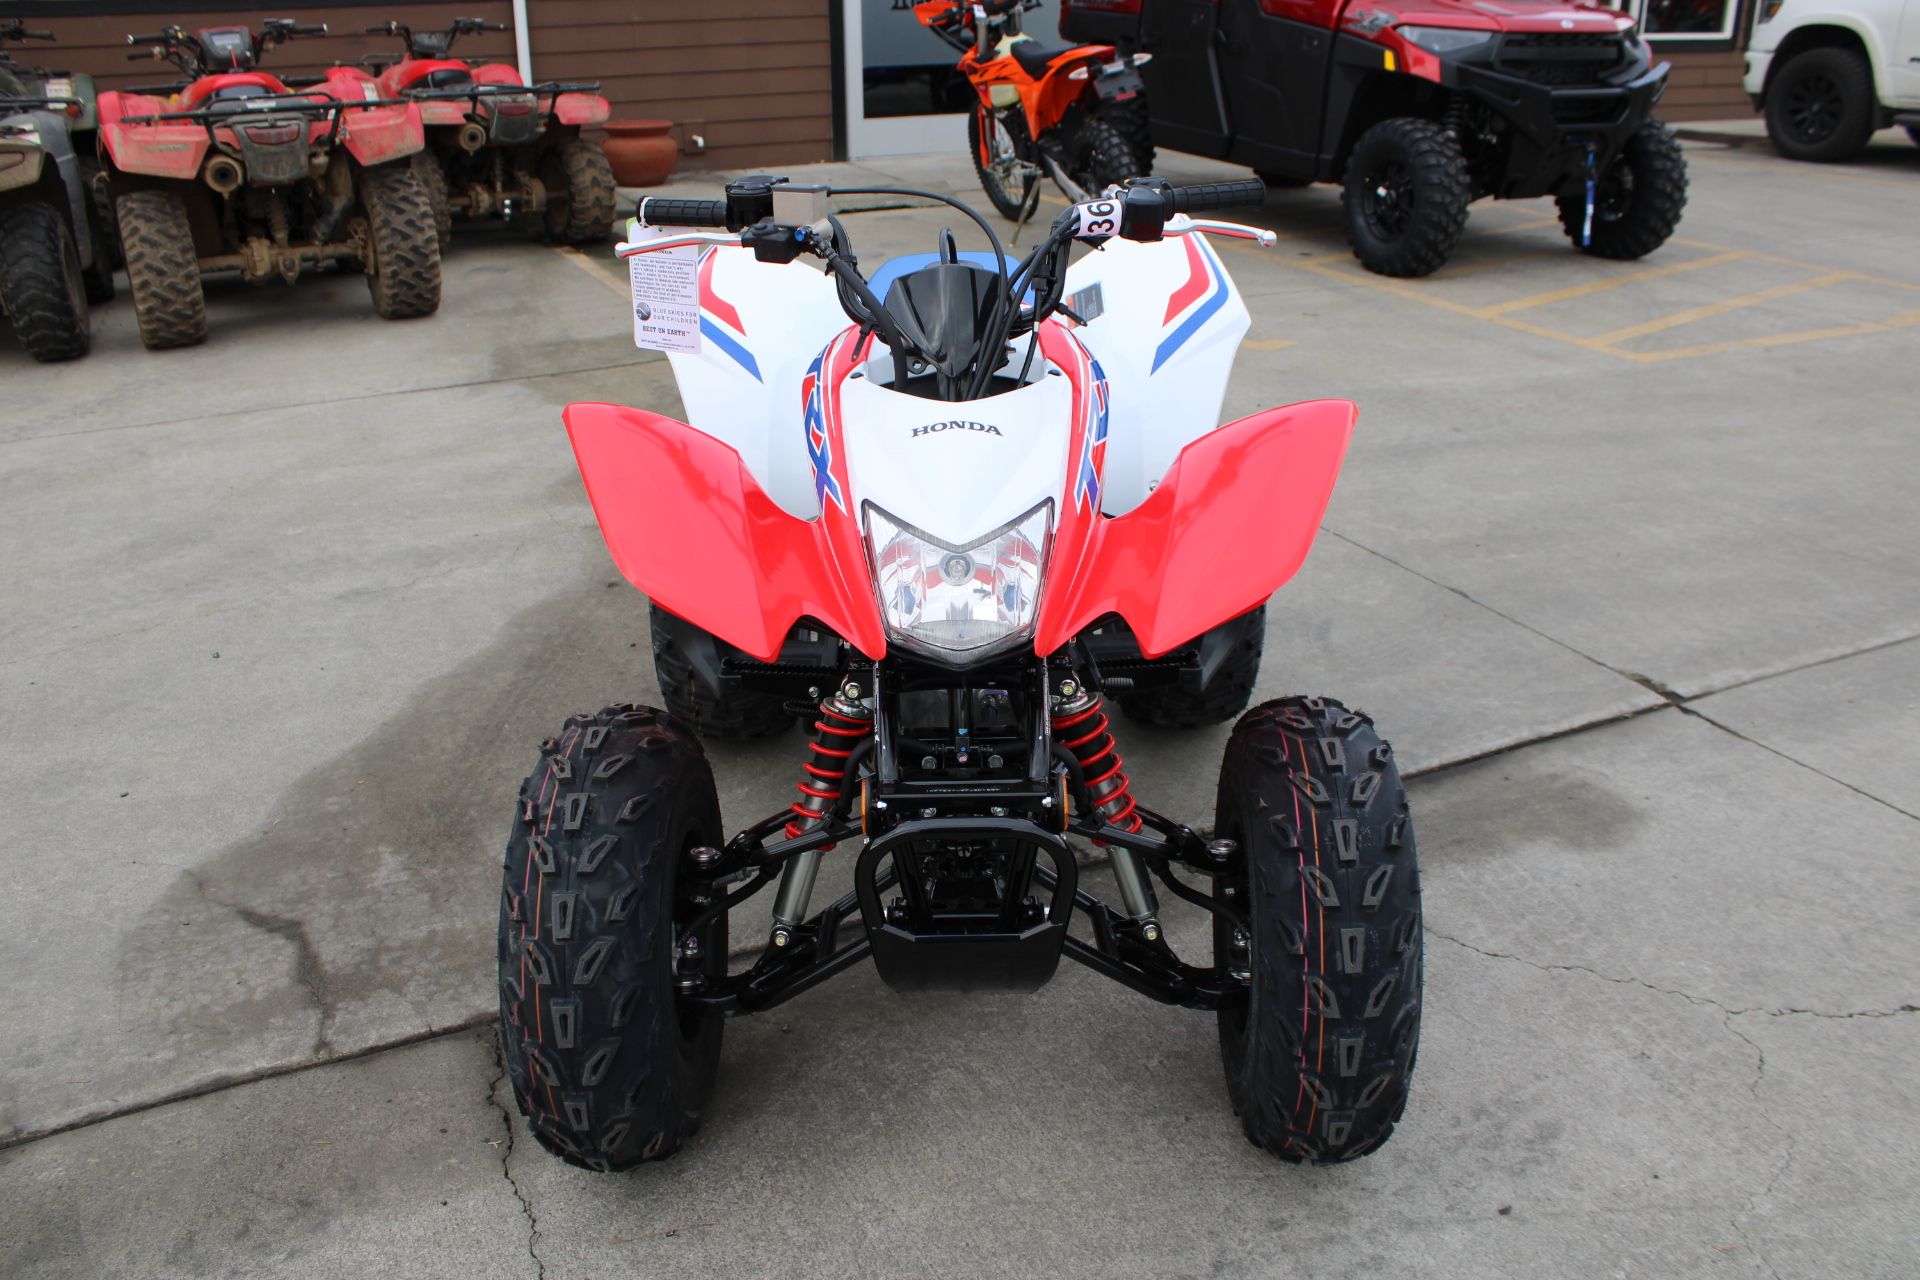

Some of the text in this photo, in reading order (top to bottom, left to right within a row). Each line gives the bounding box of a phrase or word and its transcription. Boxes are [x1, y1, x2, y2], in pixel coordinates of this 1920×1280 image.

[1087, 202, 1115, 233] 36
[666, 316, 698, 325] CHILDREN
[642, 325, 657, 333] BEST
[911, 420, 1004, 438] HONDA
